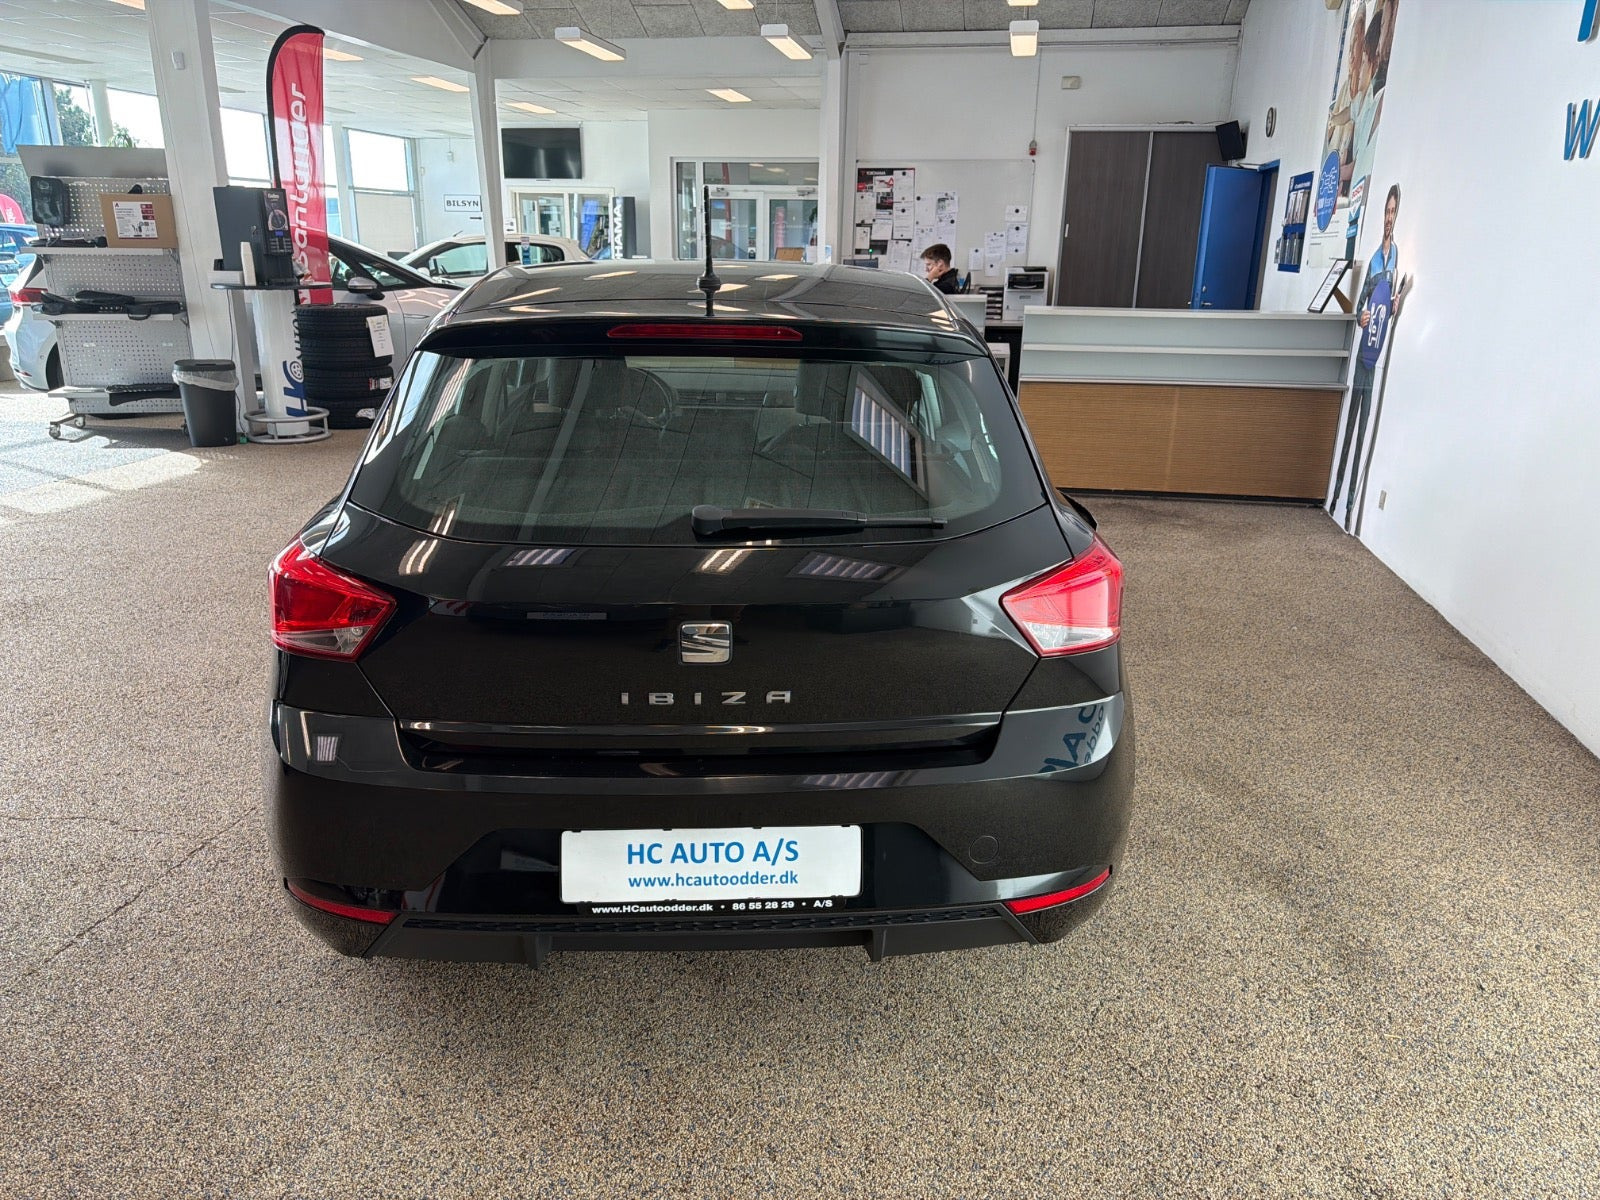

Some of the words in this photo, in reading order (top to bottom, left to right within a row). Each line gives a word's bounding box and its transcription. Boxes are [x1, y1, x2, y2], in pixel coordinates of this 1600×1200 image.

[446, 199, 479, 207] BILSYN
[613, 203, 623, 259] HAMA
[620, 690, 791, 705] IBIZA
[627, 842, 663, 865] HC
[669, 841, 745, 865] AUTO
[752, 838, 799, 866] A/S
[628, 869, 799, 888] www.hcautoodder.dk
[592, 902, 714, 914] www.HCautoodder.dk
[732, 902, 747, 911] 86
[748, 901, 762, 910] 55
[764, 901, 778, 910] 28
[781, 900, 795, 909] 29
[813, 899, 833, 908] A/S
